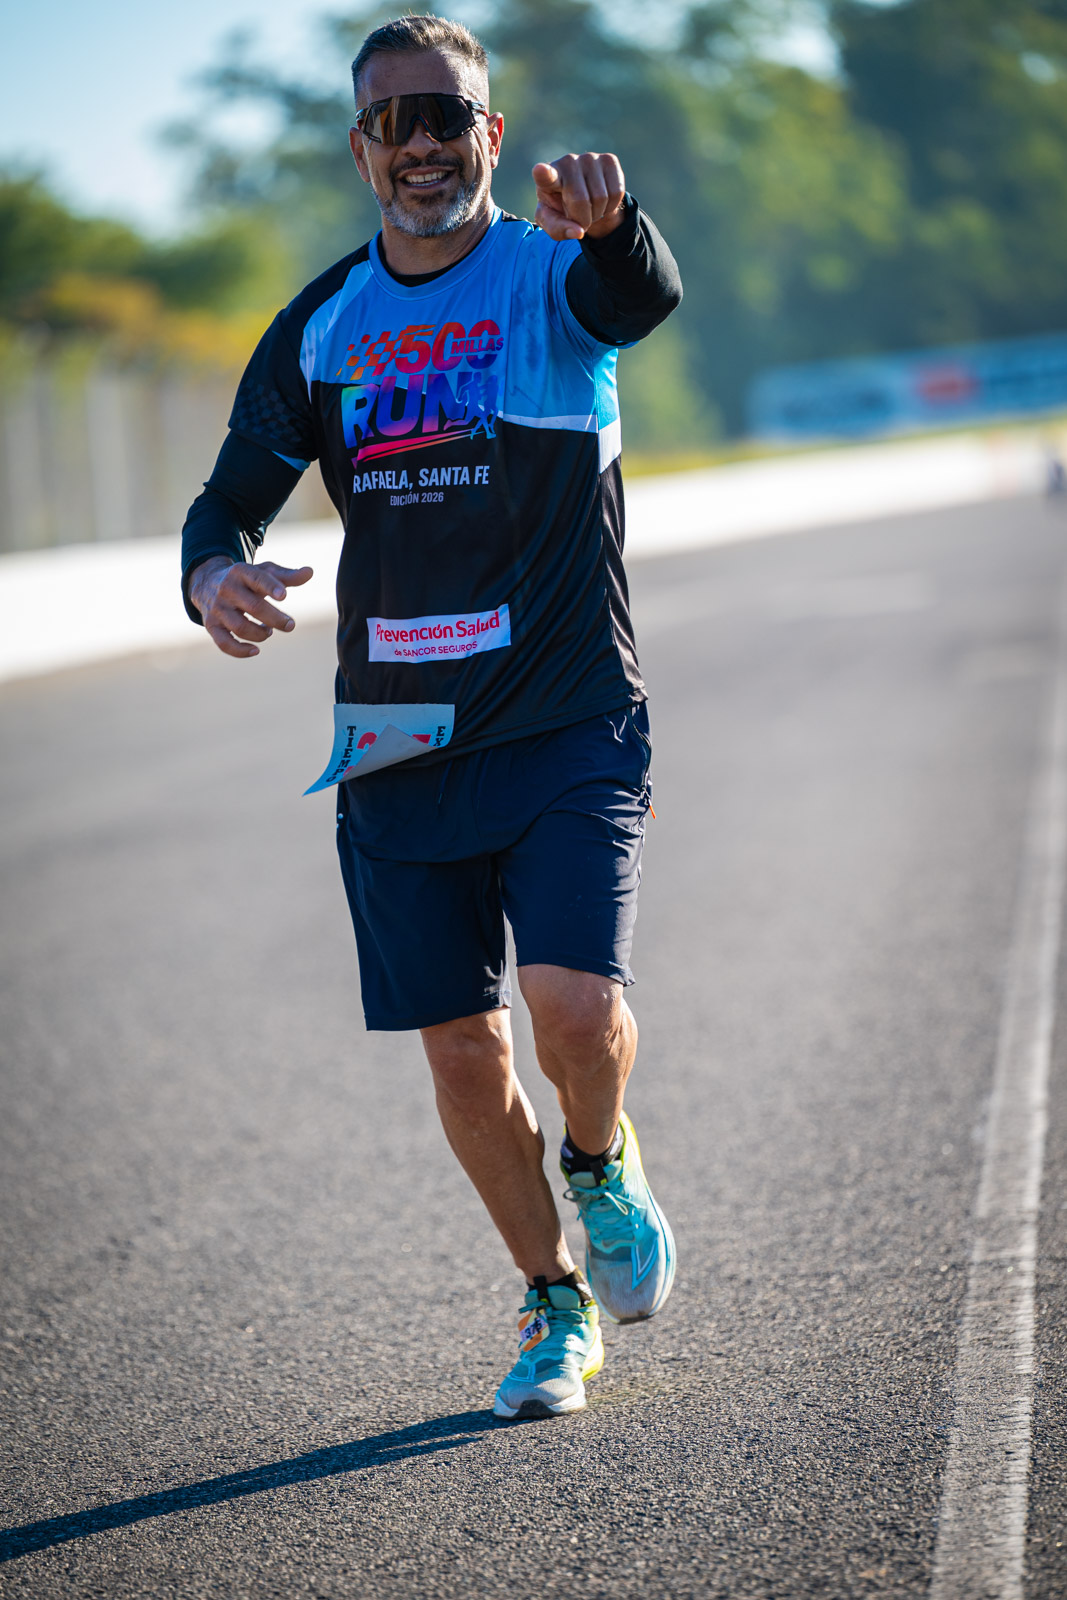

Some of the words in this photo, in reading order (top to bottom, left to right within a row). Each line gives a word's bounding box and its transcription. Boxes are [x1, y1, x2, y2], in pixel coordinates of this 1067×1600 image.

[451, 337, 504, 354] MILLAS
[341, 371, 474, 449] RUN
[353, 469, 413, 494] RAFAELA,
[418, 466, 470, 487] SANTA
[474, 465, 490, 485] FE
[390, 491, 419, 506] EDICIÓN
[421, 492, 444, 503] 2026
[376, 623, 454, 642] Prevención
[455, 611, 500, 637] Salud
[403, 646, 437, 657] SANCOR
[438, 641, 478, 654] SEGUROS
[326, 725, 357, 782] TIEMPO
